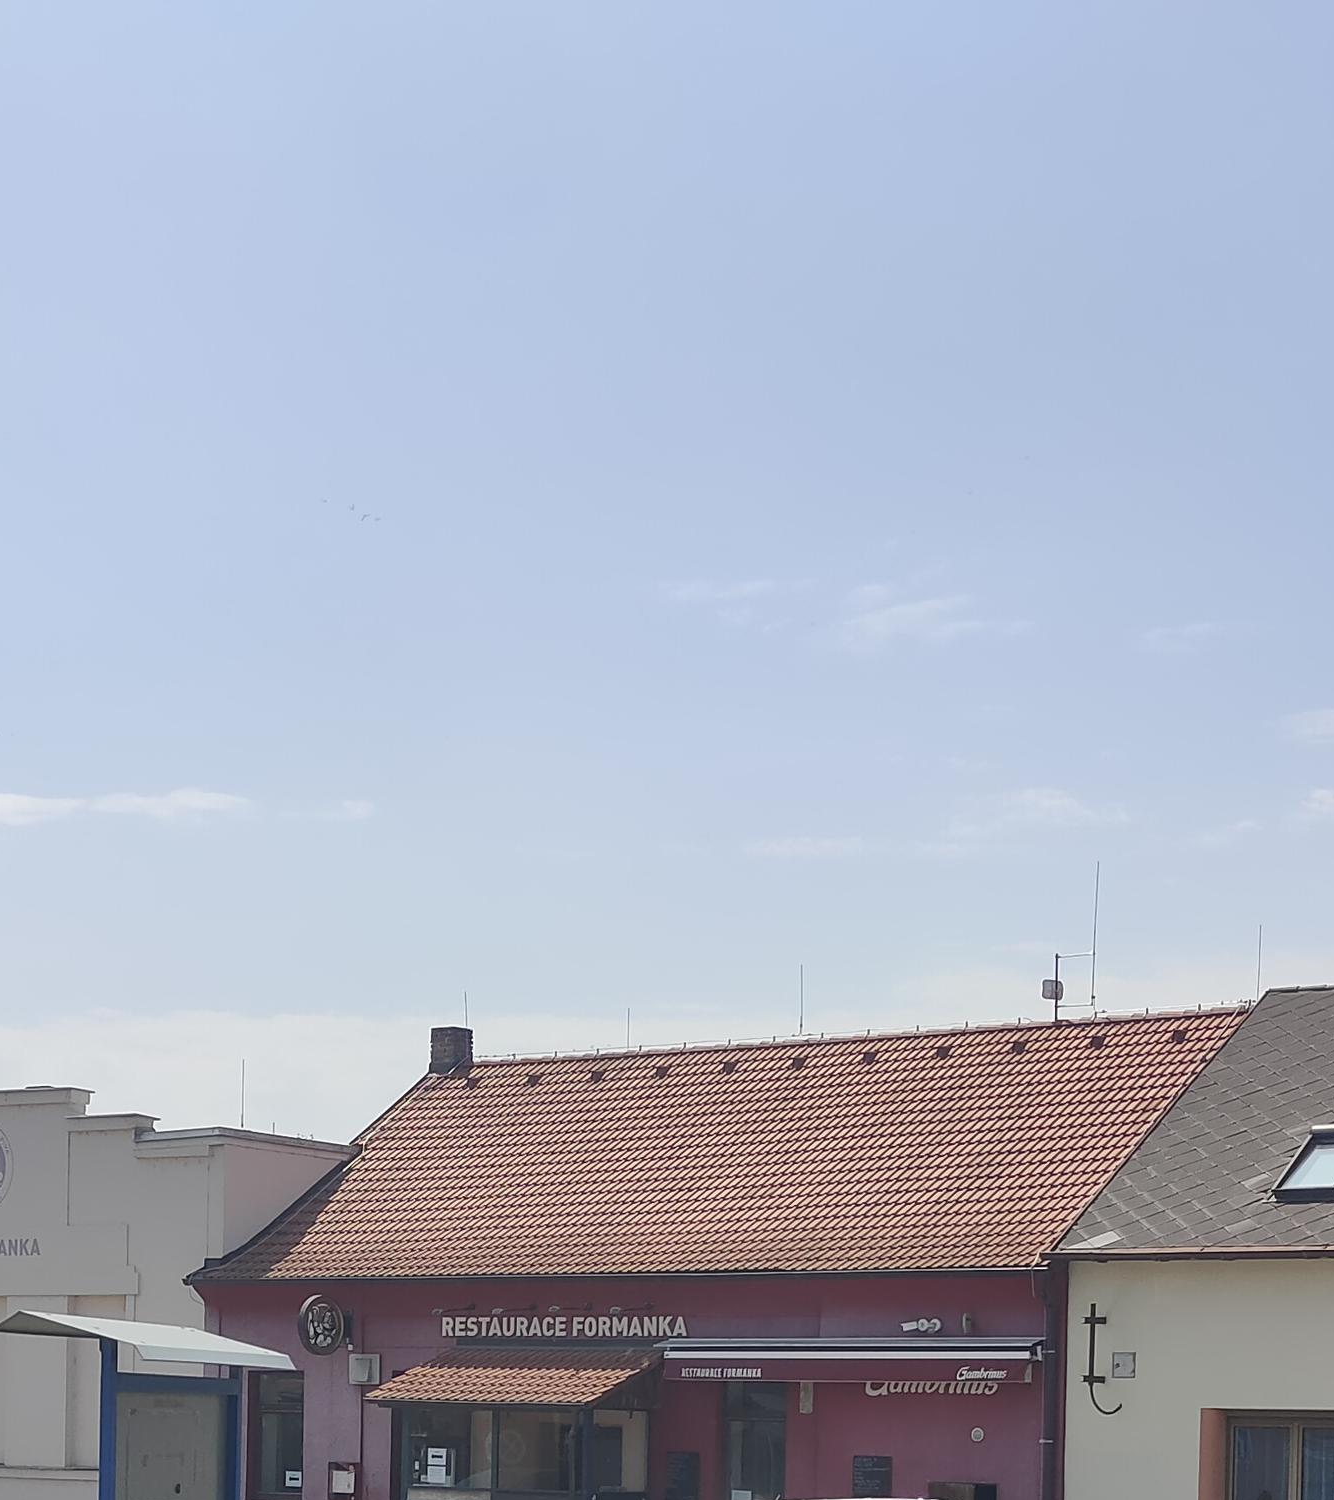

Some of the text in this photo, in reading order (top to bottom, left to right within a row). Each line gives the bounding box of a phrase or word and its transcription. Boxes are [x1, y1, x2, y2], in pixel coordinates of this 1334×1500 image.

[441, 1316, 688, 1338] RESTAURACE FORMANKA
[681, 1367, 723, 1378] RESTAURACE
[956, 1366, 1008, 1381] Gambrinus
